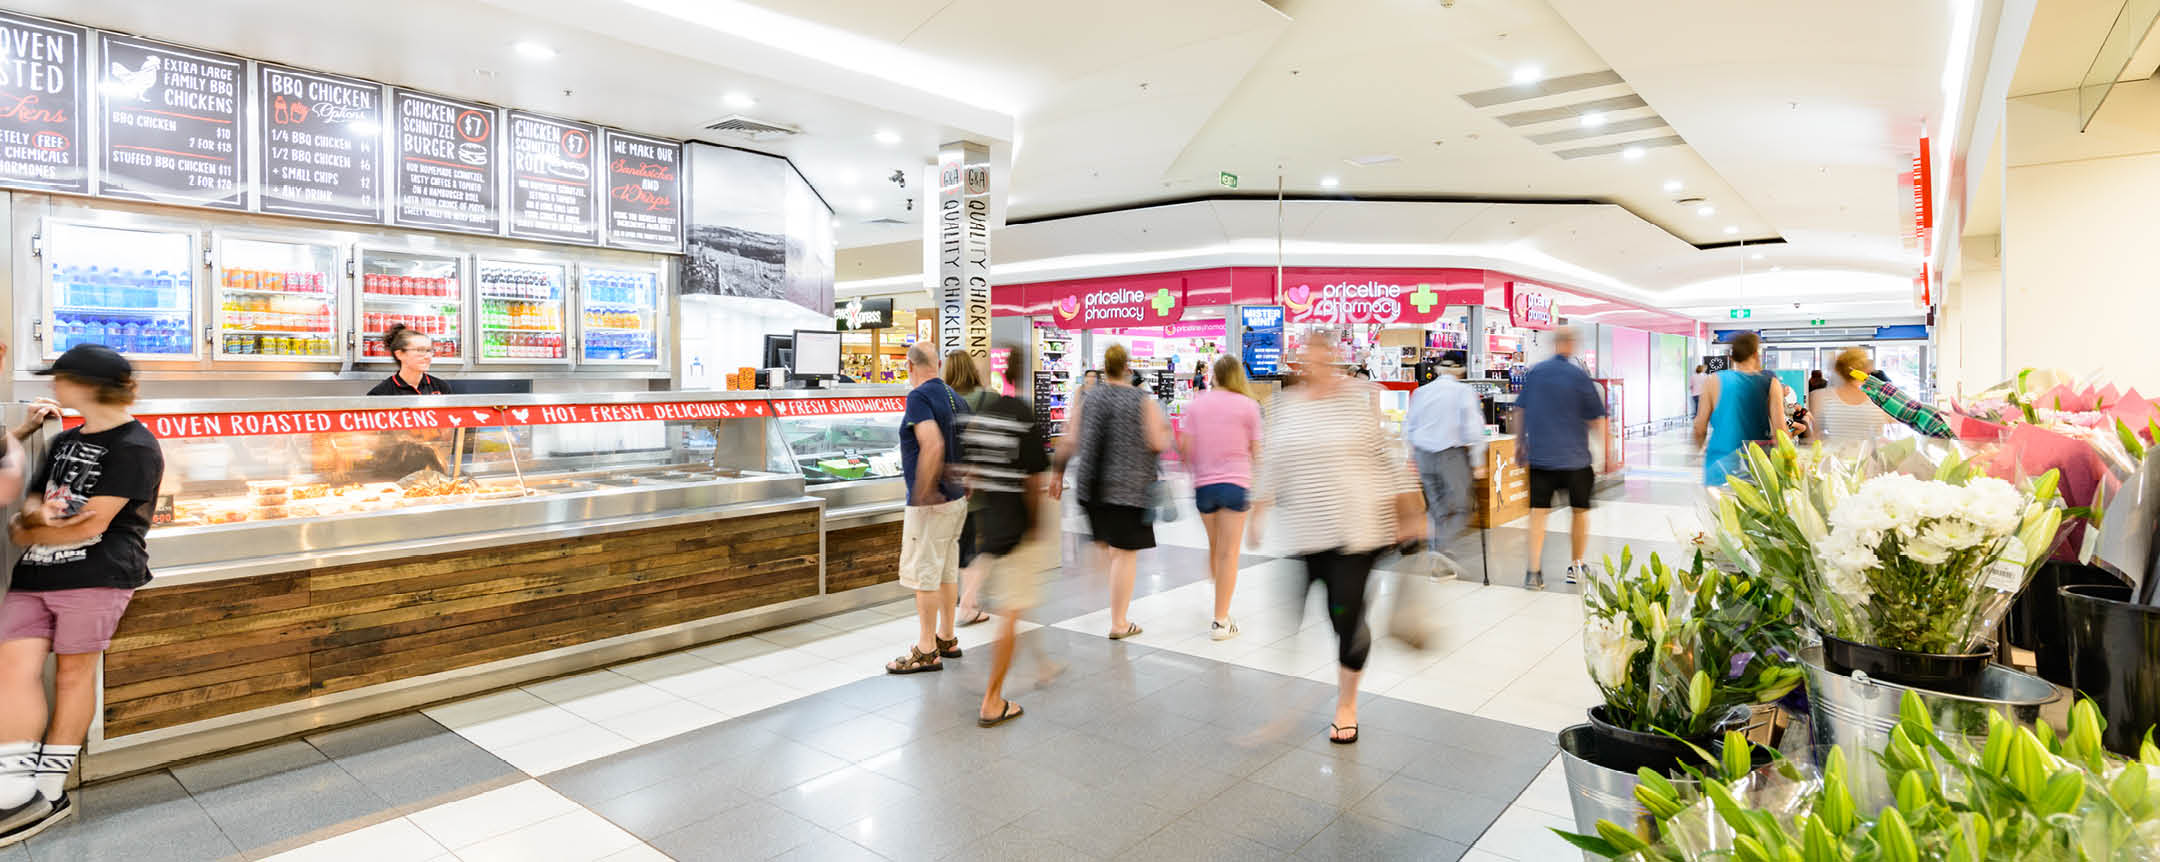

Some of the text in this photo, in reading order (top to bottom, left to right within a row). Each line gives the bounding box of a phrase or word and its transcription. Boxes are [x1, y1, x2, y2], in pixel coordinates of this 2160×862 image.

[0, 27, 64, 64] OVEN
[164, 58, 233, 81] EXTRA LARGE
[164, 72, 233, 97] FAMILY BBQ
[271, 74, 370, 109] BBQ CHICKEN
[164, 88, 233, 114] CHICKENS
[311, 101, 367, 124] Options
[403, 98, 456, 124] CHICKEN
[112, 111, 134, 126] BBQ
[137, 115, 177, 131] CHICKEN
[403, 117, 456, 141] SCHNITZEL
[464, 114, 482, 137] $7
[515, 119, 560, 143] CHICKEN
[37, 135, 65, 149] FREE
[198, 138, 215, 152] FOR
[271, 129, 289, 142] 1/4
[291, 131, 312, 146] BBQ
[314, 134, 352, 150] CHICKEN
[404, 133, 456, 160] BURGER
[515, 137, 560, 159] SCHNITZEL
[568, 134, 583, 153] $7
[614, 139, 673, 163] WE MAKE OUR
[5, 146, 69, 165] CHEMICALS
[112, 150, 152, 167] STUFFED
[155, 155, 175, 170] BBQ
[178, 160, 216, 175] CHICKEN
[271, 147, 289, 160] 1/2
[291, 148, 312, 164] BBQ
[314, 152, 352, 168] CHICKEN
[197, 176, 214, 189] FOR
[282, 166, 311, 182] SMALL
[314, 170, 339, 186] CHIPS
[360, 177, 371, 190] $2
[642, 178, 660, 192] AND
[281, 184, 302, 199] ANY
[305, 187, 333, 201] DRINK
[943, 199, 961, 268] QUALITY
[968, 199, 988, 359] QUALITY CHICKENS
[1085, 288, 1145, 310] priceline
[1323, 281, 1400, 301] priceline
[1085, 305, 1145, 323] pharmacy
[1323, 297, 1401, 318] pharmacy
[542, 400, 735, 424] HOT. FRESH. DELICIOUS.
[789, 396, 905, 416] FRESH SANDWICHES
[157, 408, 439, 437] OVEN ROASTED CHICKENS
